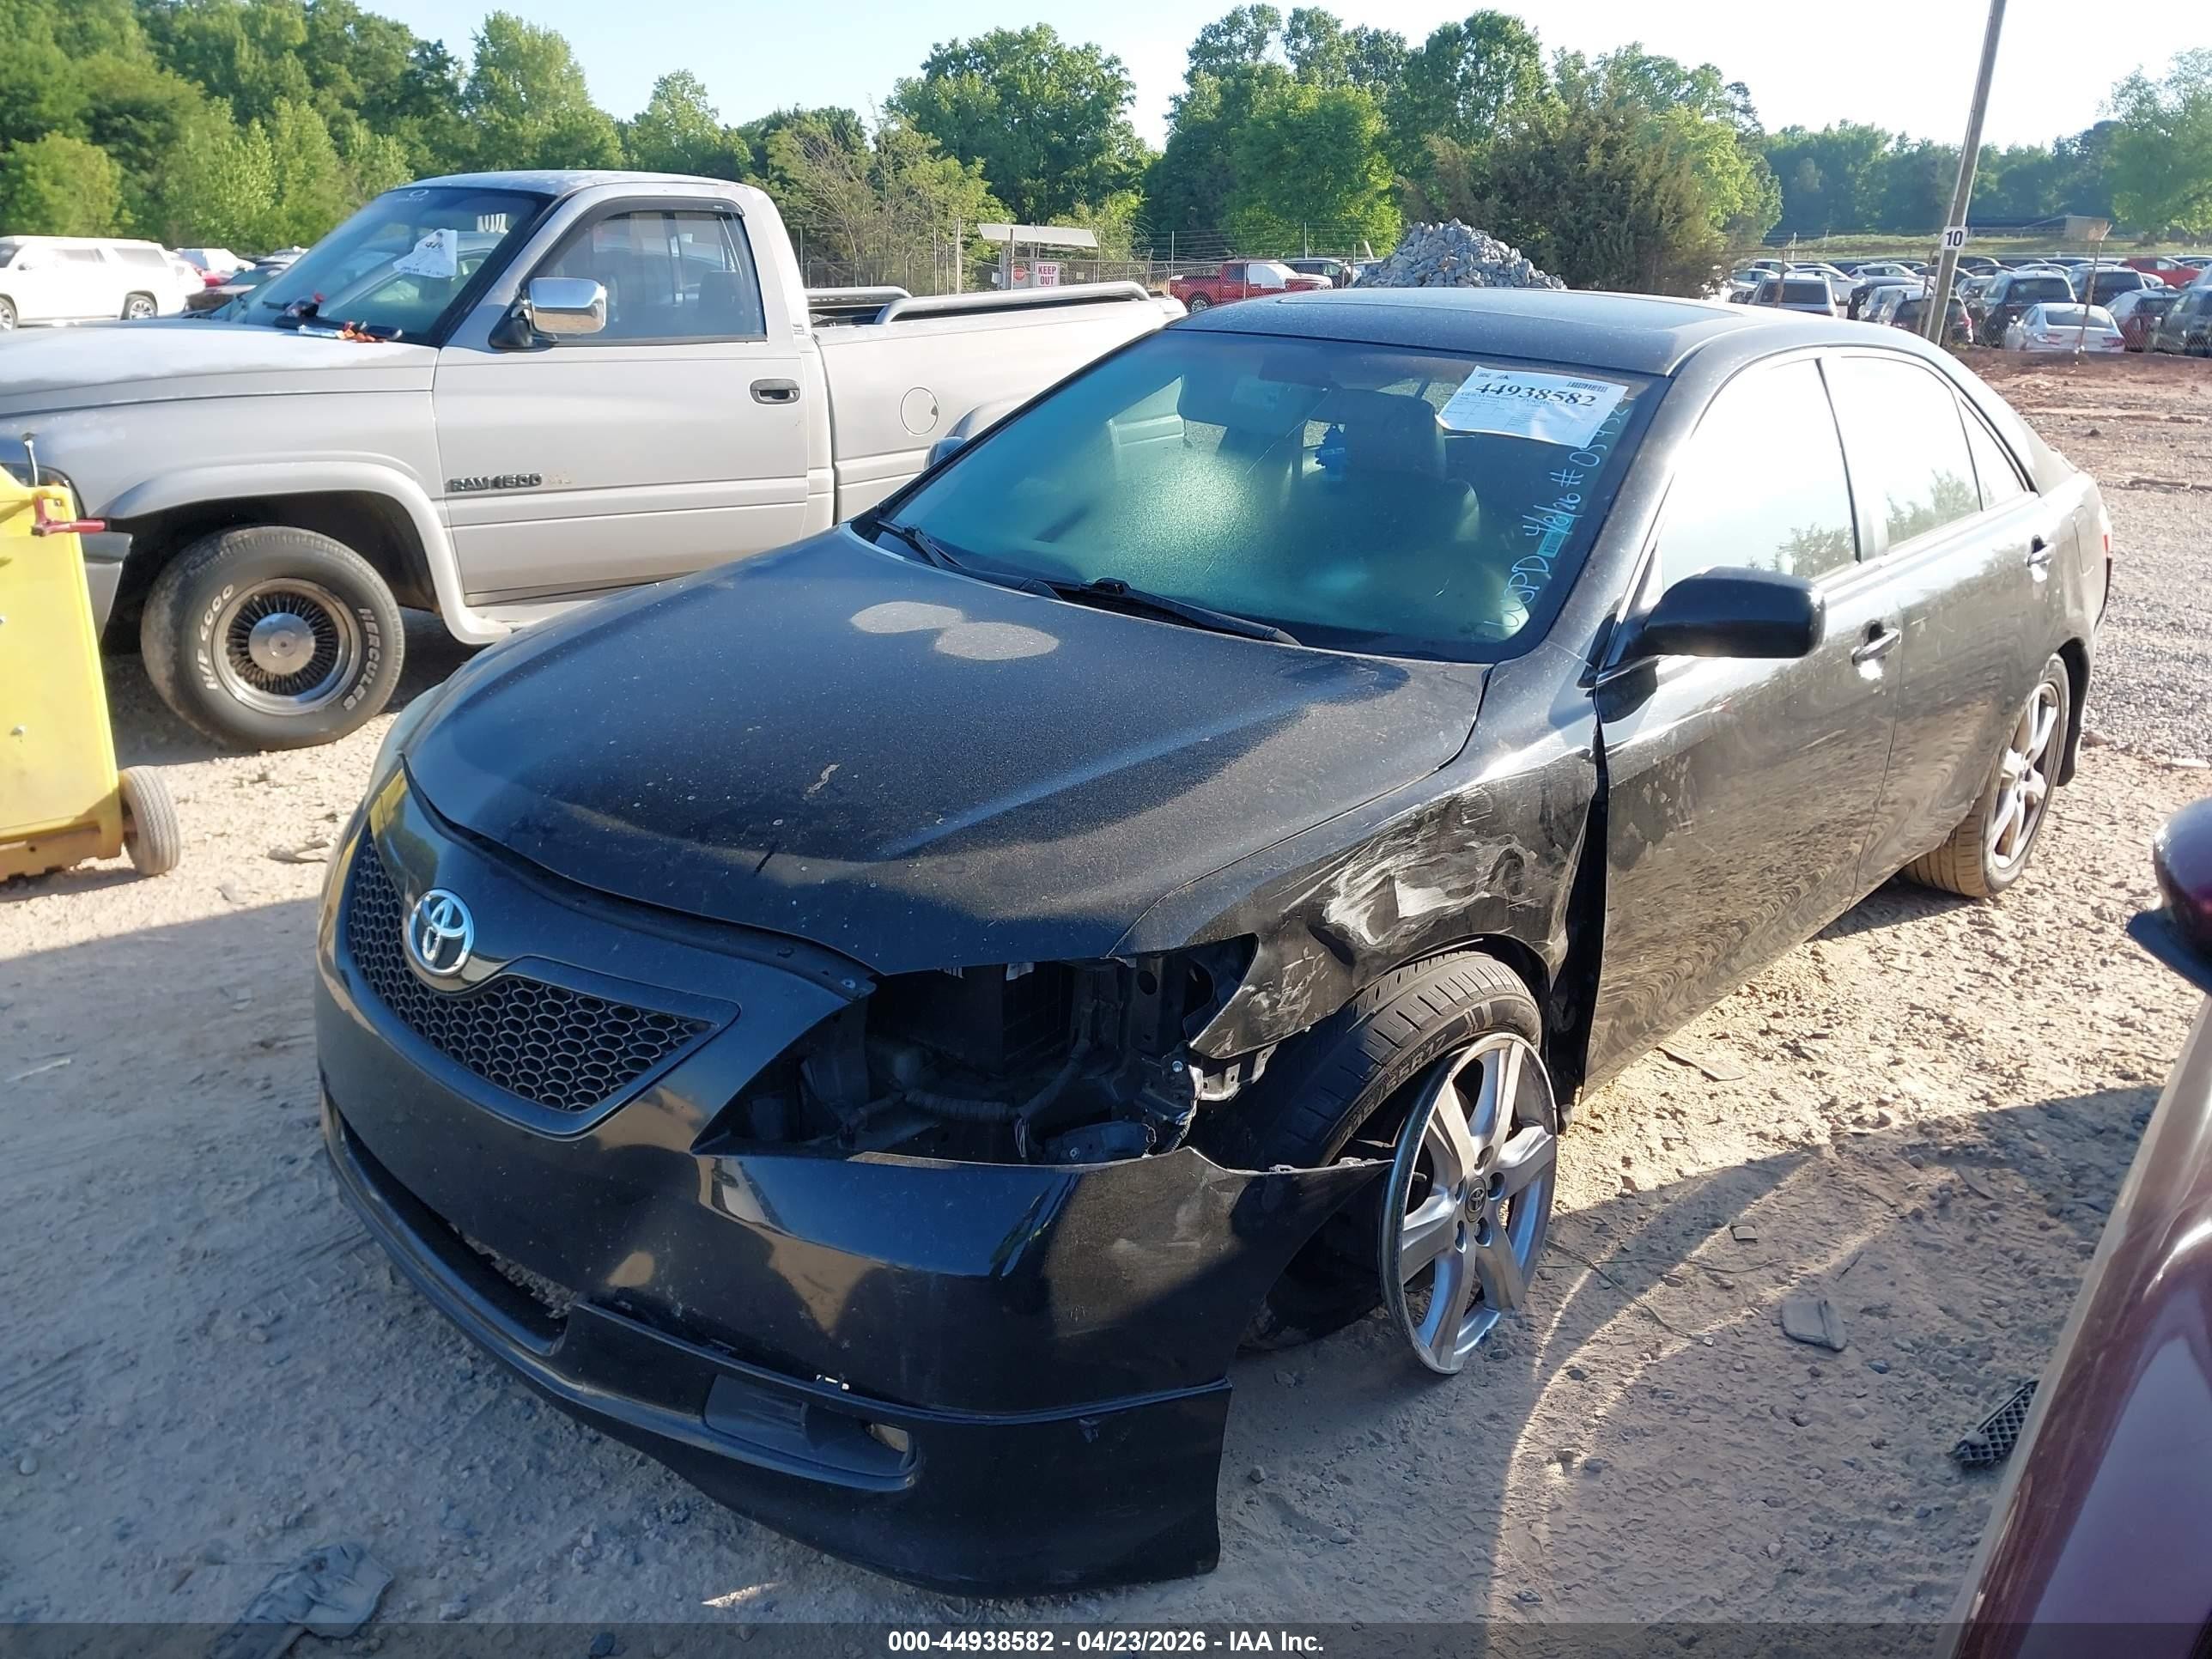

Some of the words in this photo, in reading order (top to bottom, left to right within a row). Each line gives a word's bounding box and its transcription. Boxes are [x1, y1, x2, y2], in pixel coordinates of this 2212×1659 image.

[1946, 230, 1963, 246] 10
[1038, 265, 1056, 275] KEEP
[1040, 276, 1054, 285] OUT
[1475, 382, 1596, 407] 44938582
[448, 477, 489, 492] RAM
[490, 473, 543, 489] 1500
[199, 584, 234, 641] 4000
[343, 607, 380, 711] HERCULES
